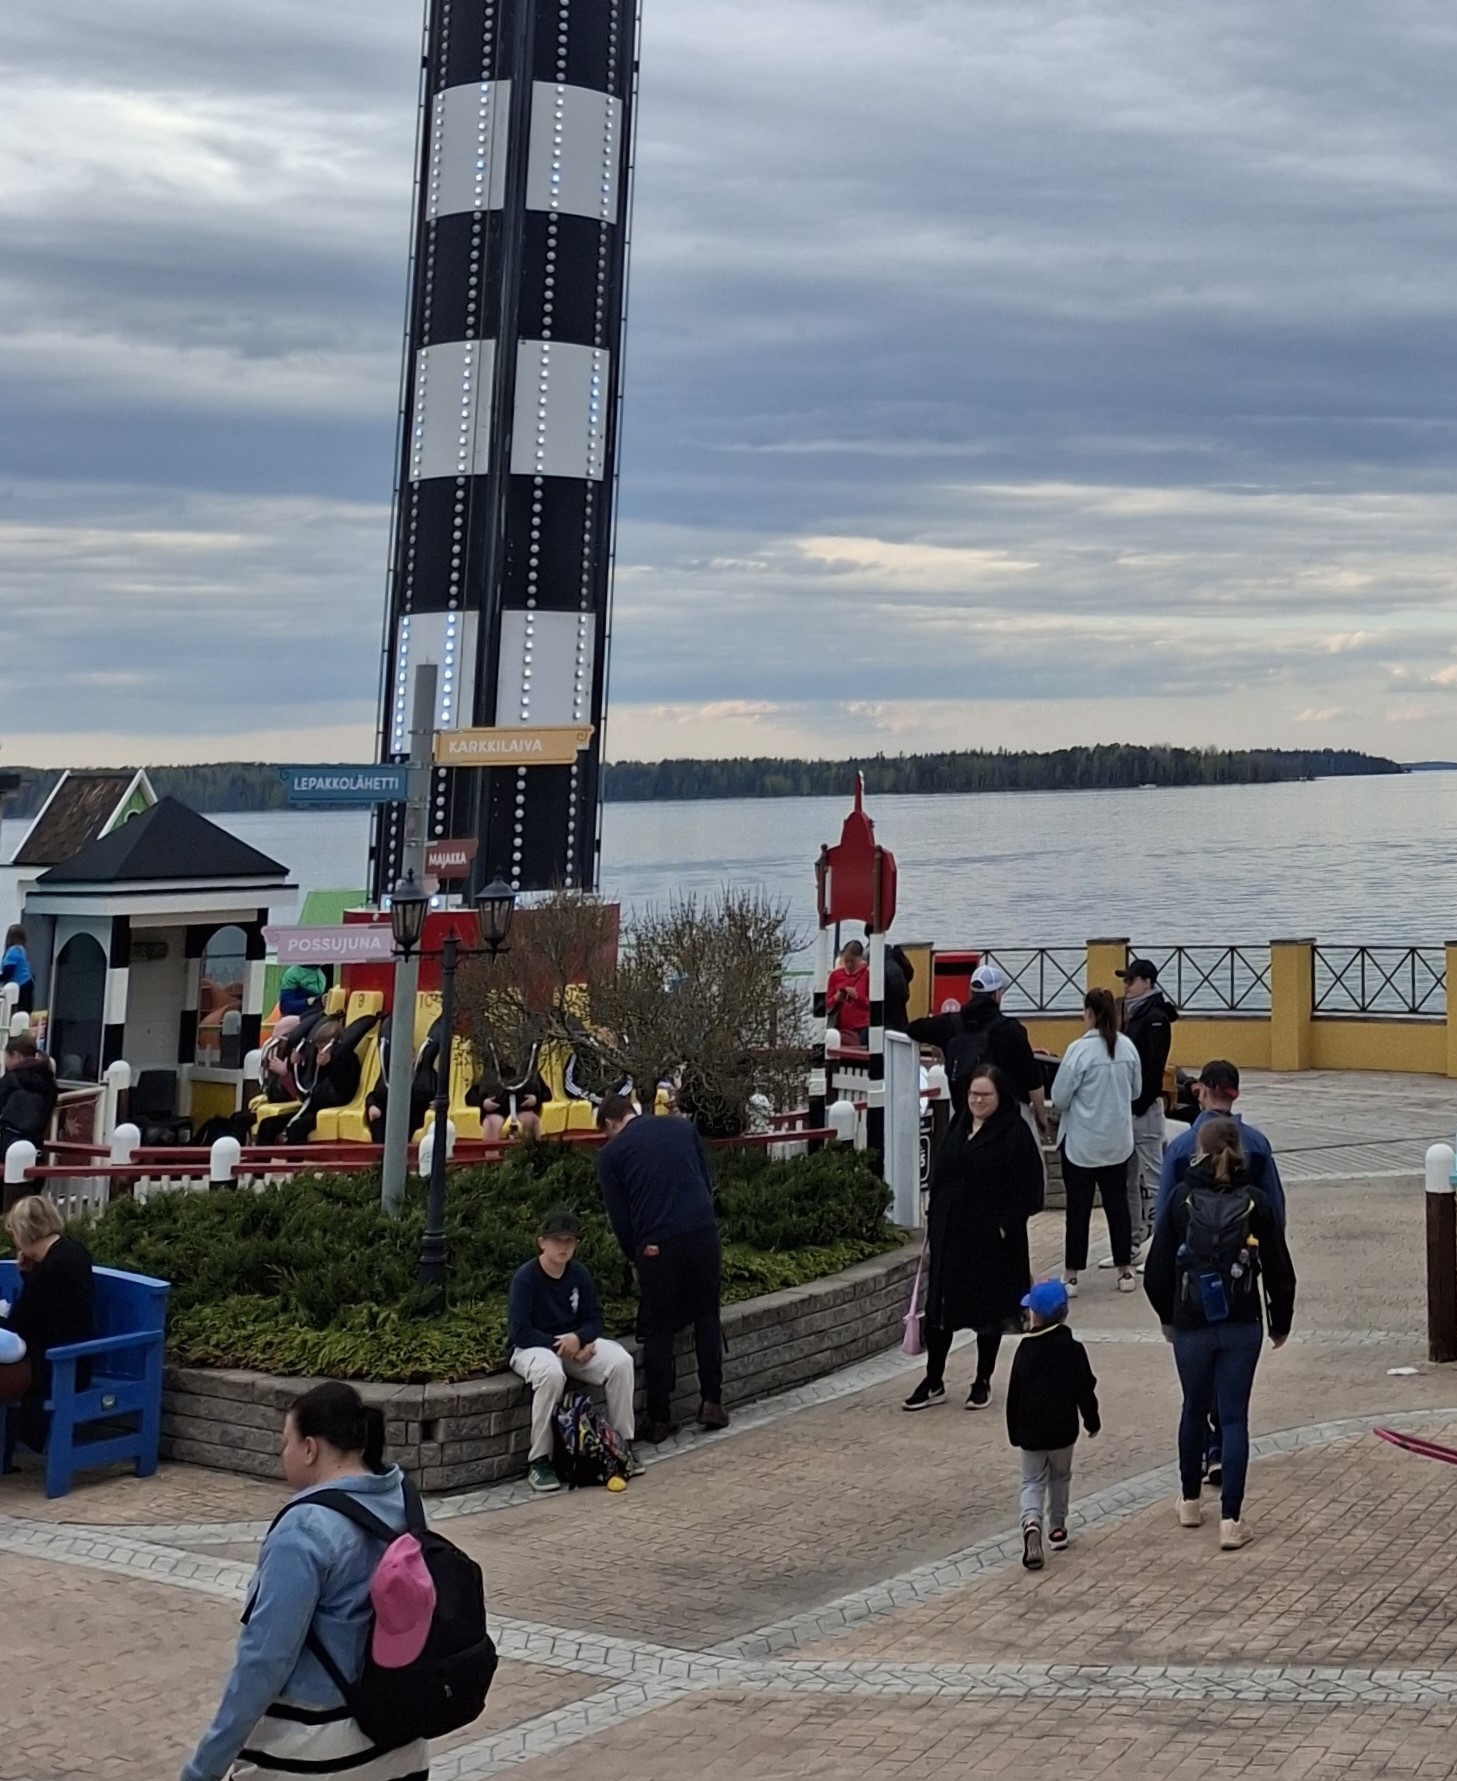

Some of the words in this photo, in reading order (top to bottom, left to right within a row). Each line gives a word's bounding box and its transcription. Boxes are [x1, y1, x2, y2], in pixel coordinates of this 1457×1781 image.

[449, 739, 542, 753] KARKKILAIVA
[294, 774, 399, 791] LEPAKKOLÄHETTI
[428, 852, 467, 868] MAJAKKA
[288, 937, 381, 952] POSSUJUNA
